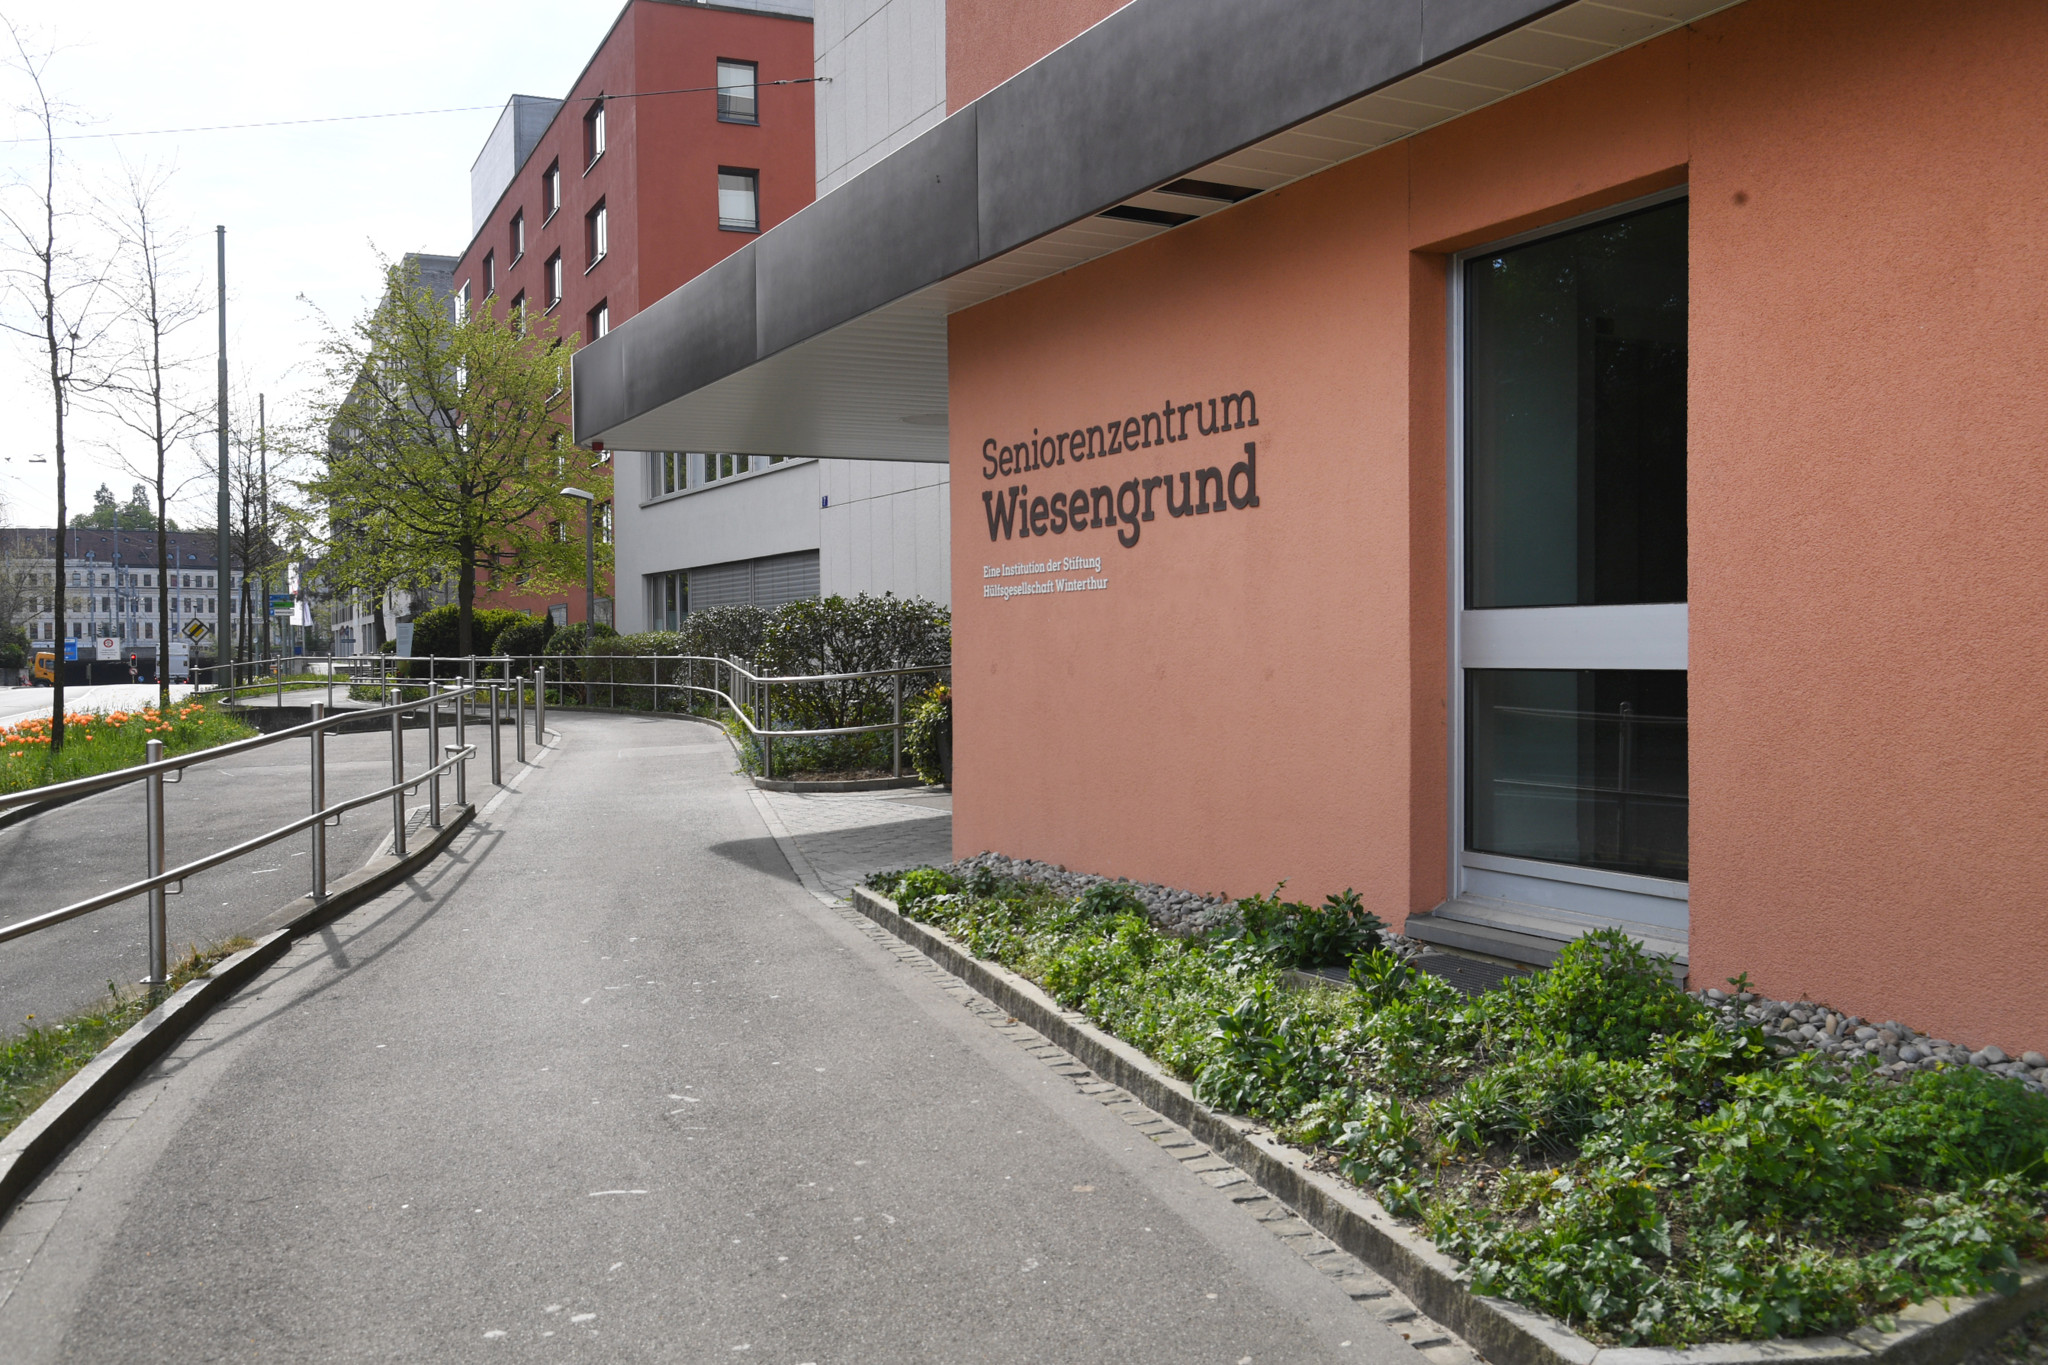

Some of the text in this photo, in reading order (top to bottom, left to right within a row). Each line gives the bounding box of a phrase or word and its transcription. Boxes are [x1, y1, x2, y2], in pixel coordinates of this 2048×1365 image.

[982, 390, 1259, 480] Seniorenzentrum
[982, 441, 1259, 548] Wiesengrund
[983, 556, 1101, 578] Eine Institution der Stiftung
[983, 576, 1108, 600] Hülfsgesellschaft Winterthur
